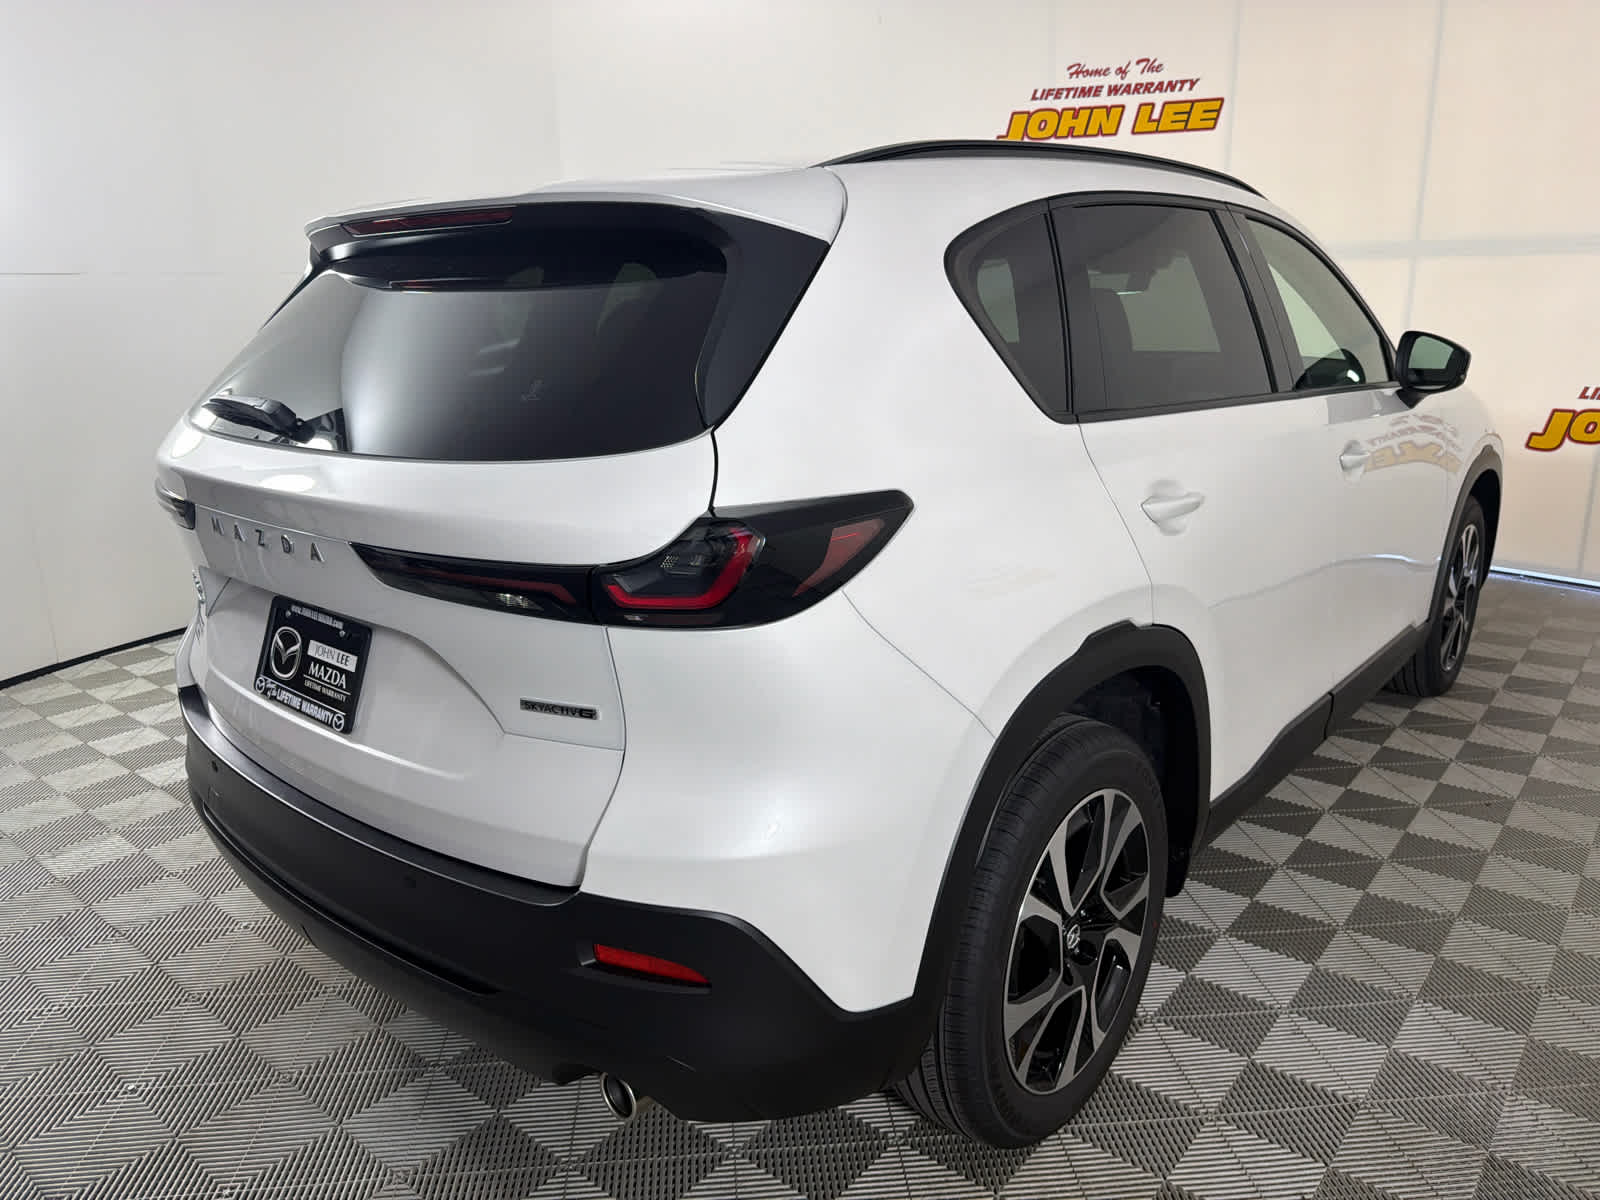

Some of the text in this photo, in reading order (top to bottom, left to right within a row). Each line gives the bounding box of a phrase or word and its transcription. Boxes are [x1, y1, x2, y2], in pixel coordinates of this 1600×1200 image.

[1066, 58, 1164, 80] Home of The
[1030, 78, 1200, 101] LIFETIME WARRANTY
[996, 97, 1225, 141] JOHN LEE
[209, 513, 325, 562] MAZDA
[314, 645, 350, 666] JOHN LEE
[308, 661, 346, 689] MAZDA
[276, 688, 302, 710] LIFETIME
[301, 699, 333, 725] WARRANTY
